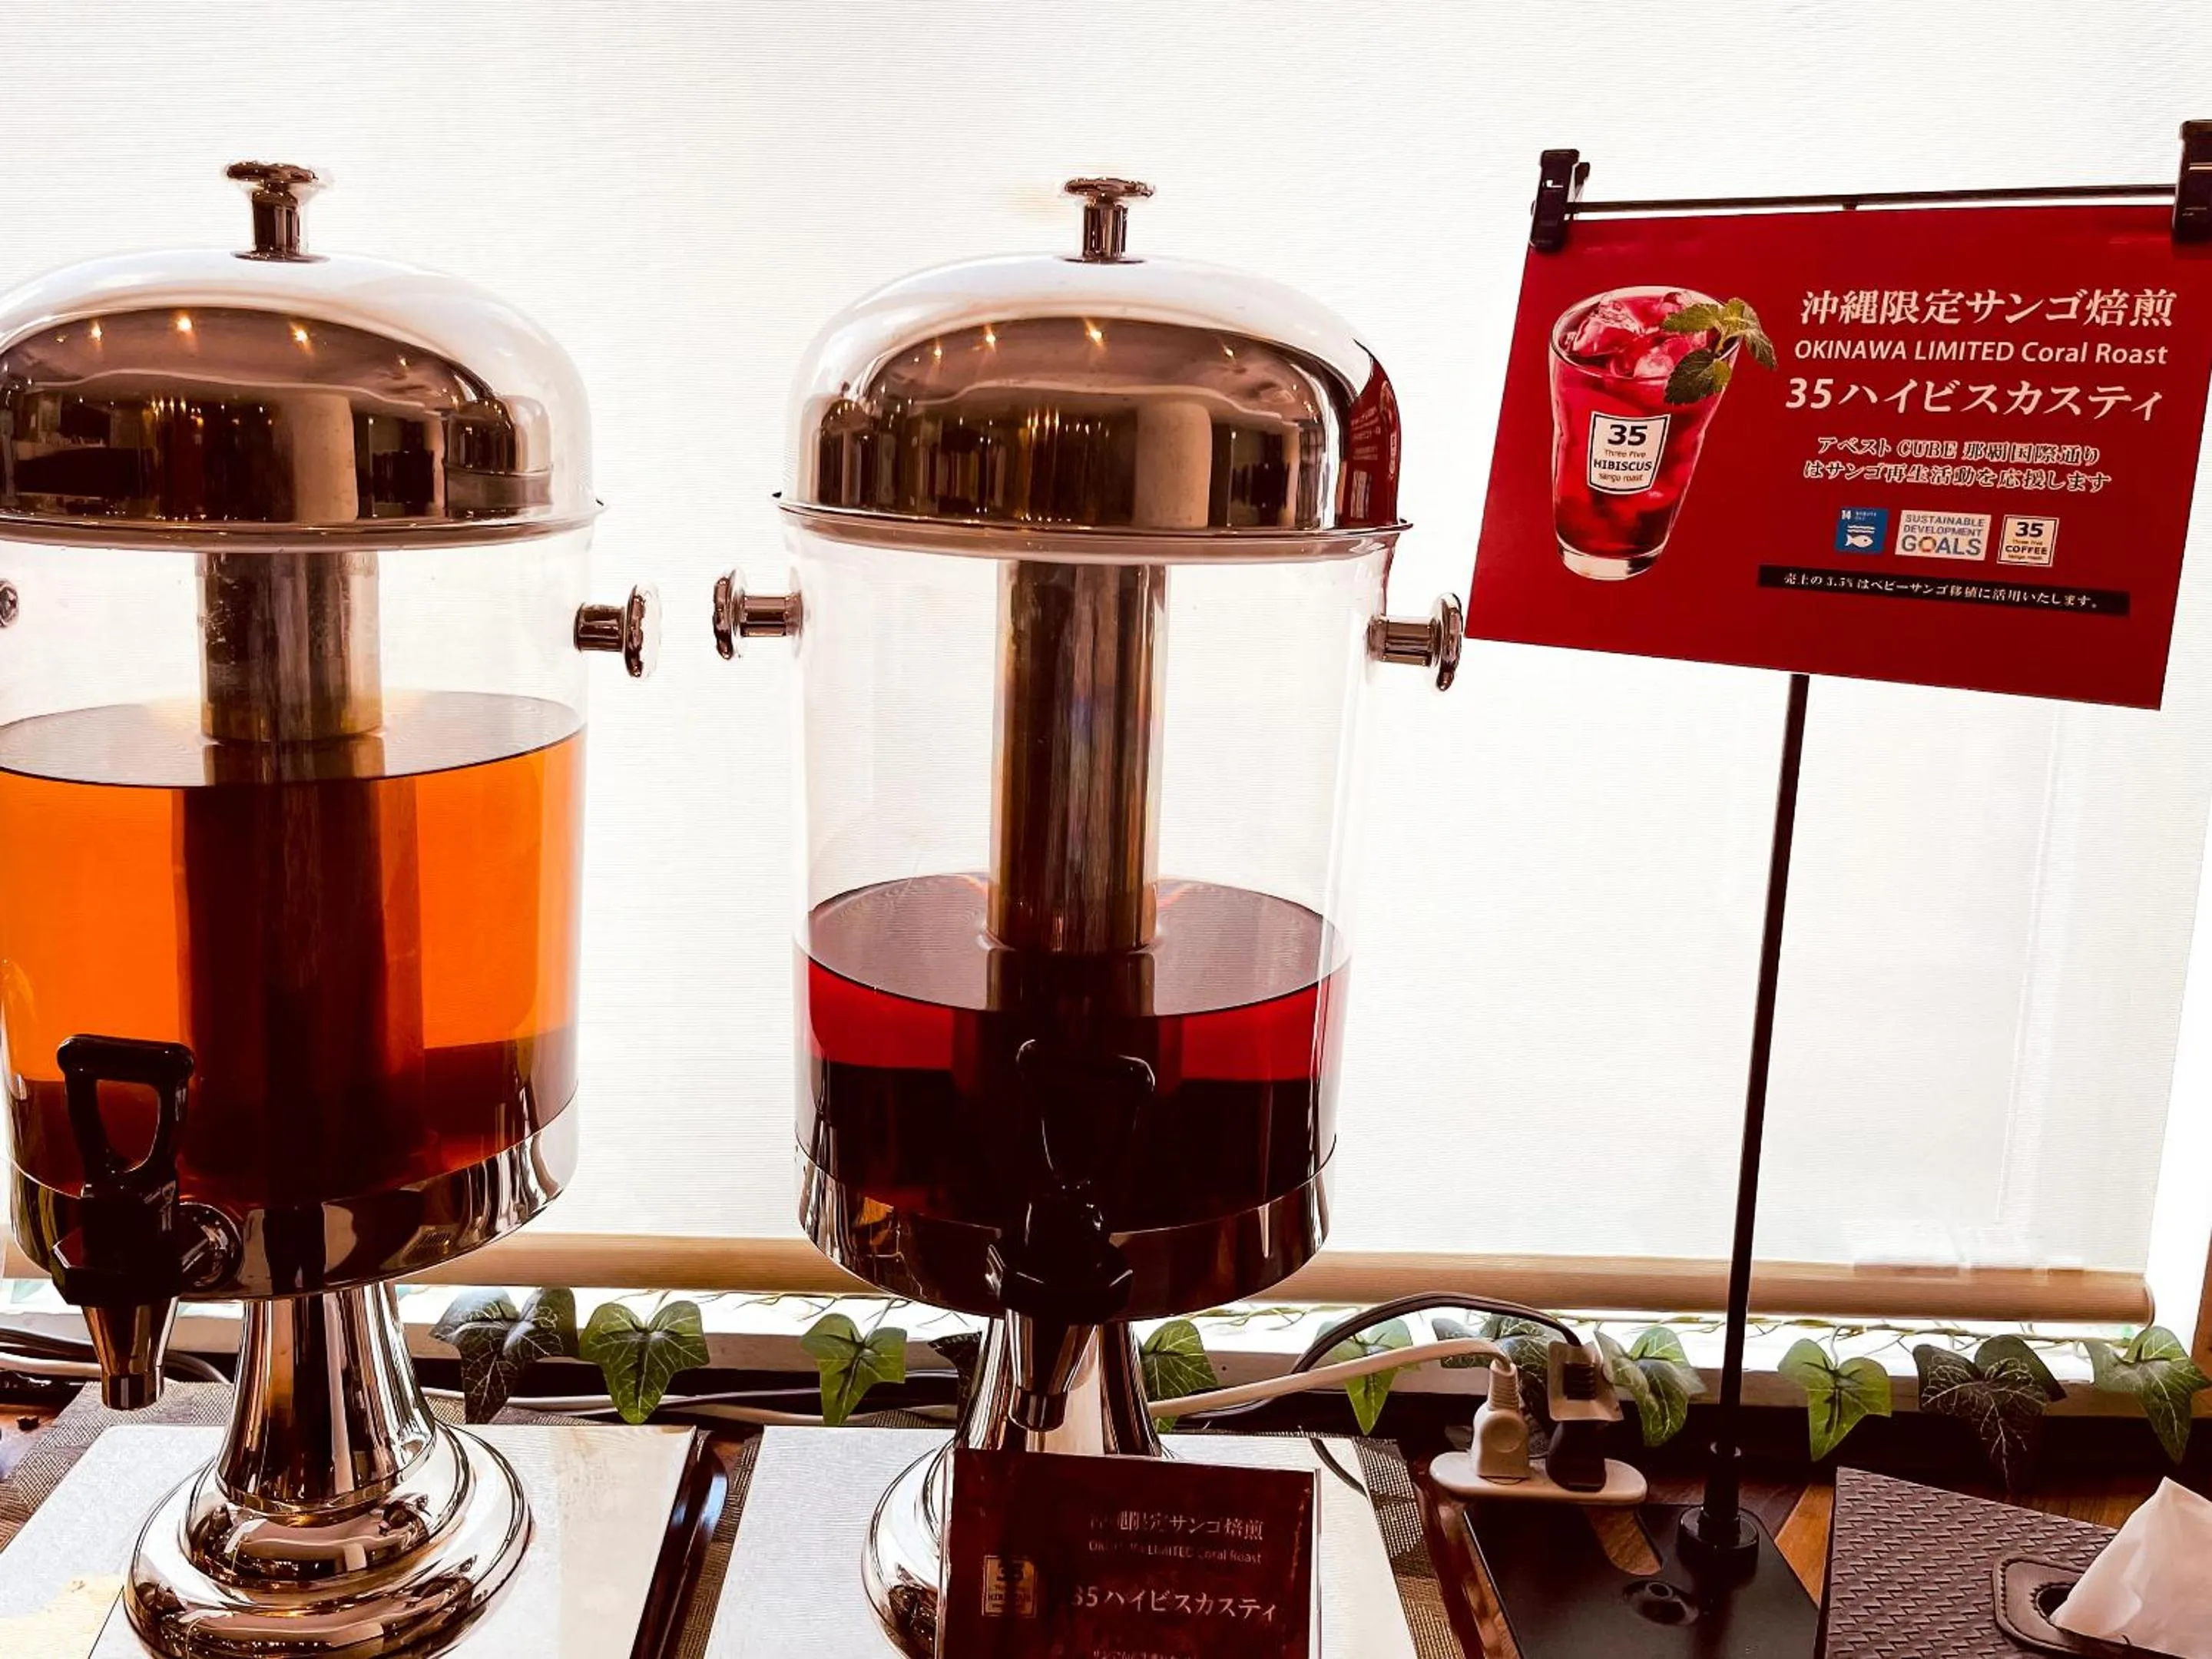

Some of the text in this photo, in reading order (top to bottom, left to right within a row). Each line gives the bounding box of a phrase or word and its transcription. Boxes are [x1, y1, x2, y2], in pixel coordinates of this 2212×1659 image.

[1800, 288, 2177, 327] 沖縄限定サンゴ焙煎
[1794, 339, 2169, 366] OKINAWA LIMITED Coral Roast
[1607, 424, 1648, 446] 35
[1897, 439, 1958, 460] CUBE
[1593, 459, 1653, 472] HIBISCUS
[1802, 459, 2112, 493] はサンゴ再生活動を応援します
[1902, 524, 1984, 537] DEVELOPMENT
[1905, 514, 1986, 527] SUSTAINABLE
[2015, 522, 2045, 538] 35
[1900, 534, 1982, 557] GOALS
[2005, 545, 2048, 555] COFFEE
